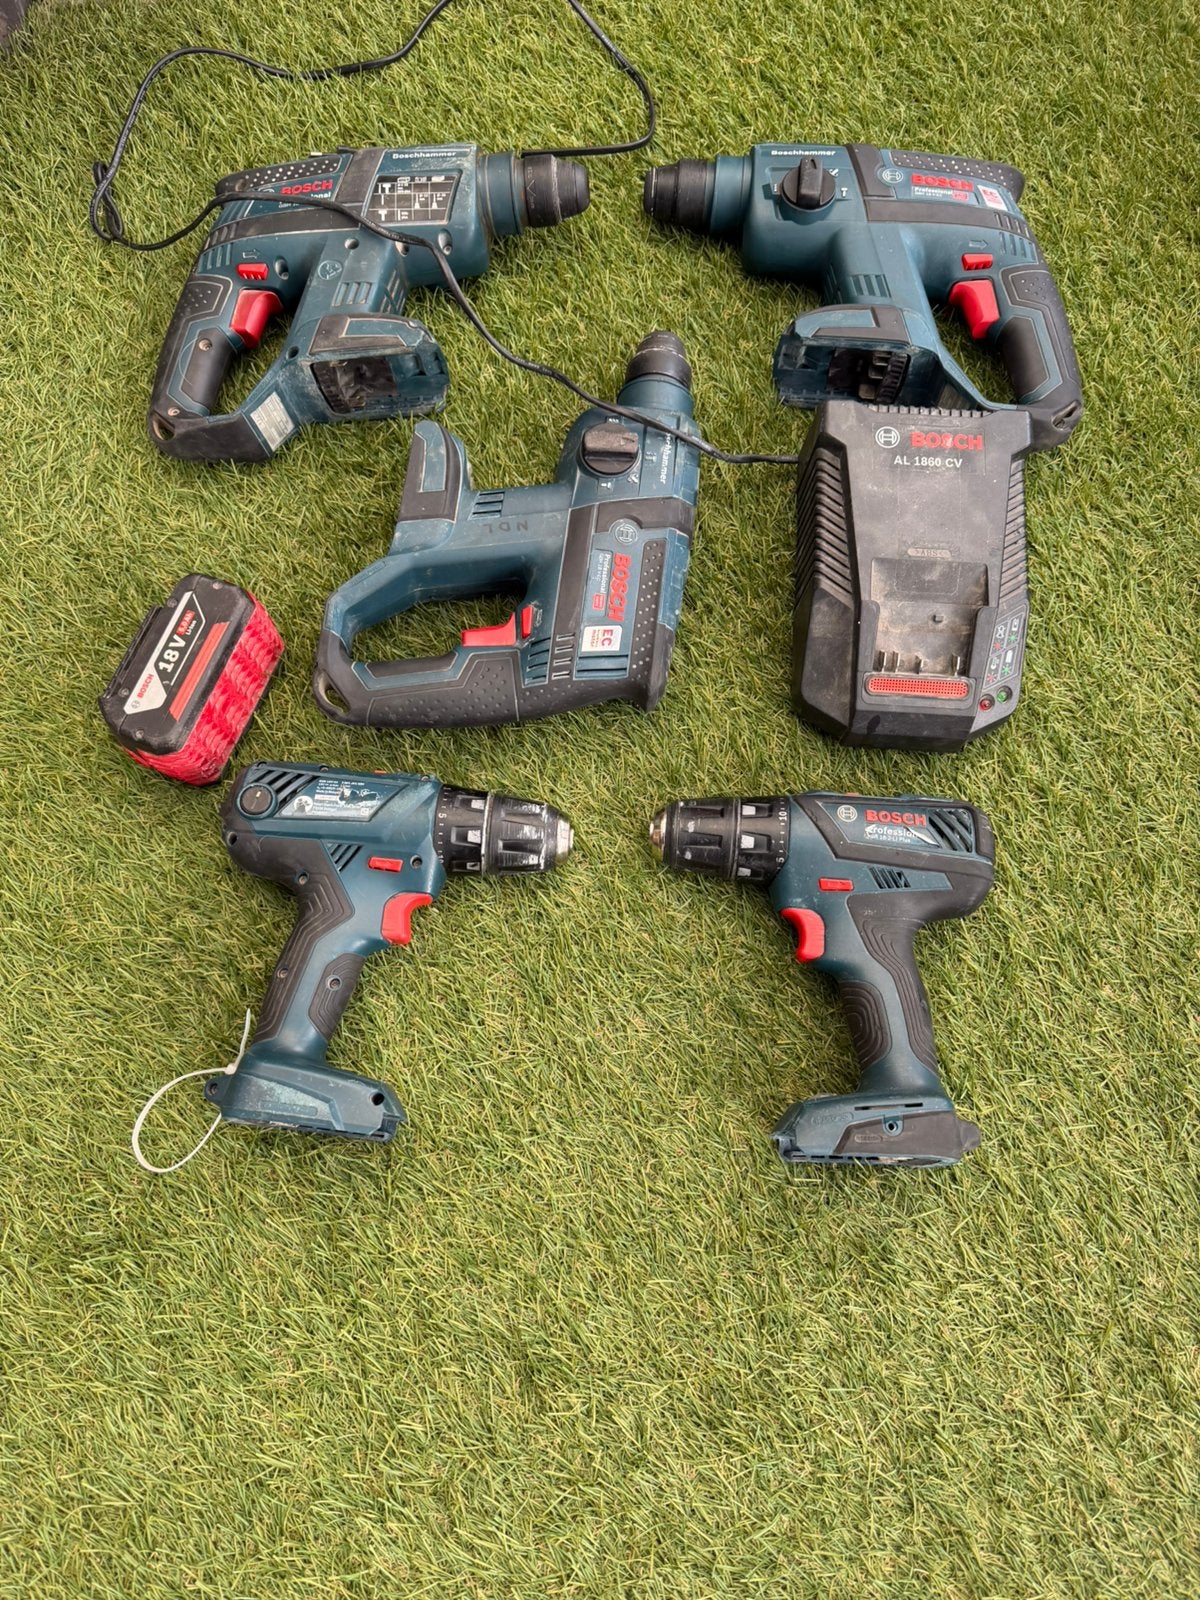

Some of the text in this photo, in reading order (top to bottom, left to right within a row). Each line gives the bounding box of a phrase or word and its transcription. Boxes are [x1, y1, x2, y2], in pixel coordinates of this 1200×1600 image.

[392, 152, 456, 160] Boschhammer
[281, 180, 333, 195] BOSCH
[911, 173, 974, 192] BOSCH
[910, 431, 983, 451] BOSCH
[660, 432, 673, 484] schhammer
[893, 455, 963, 468] AL 1860 CV
[600, 553, 611, 594] Professional
[607, 552, 632, 623] BOSCH
[601, 629, 613, 647] EC
[137, 673, 154, 698] BOSCH
[778, 811, 787, 821] 10
[865, 809, 927, 827] BOSCH
[866, 825, 917, 838] rofessio
